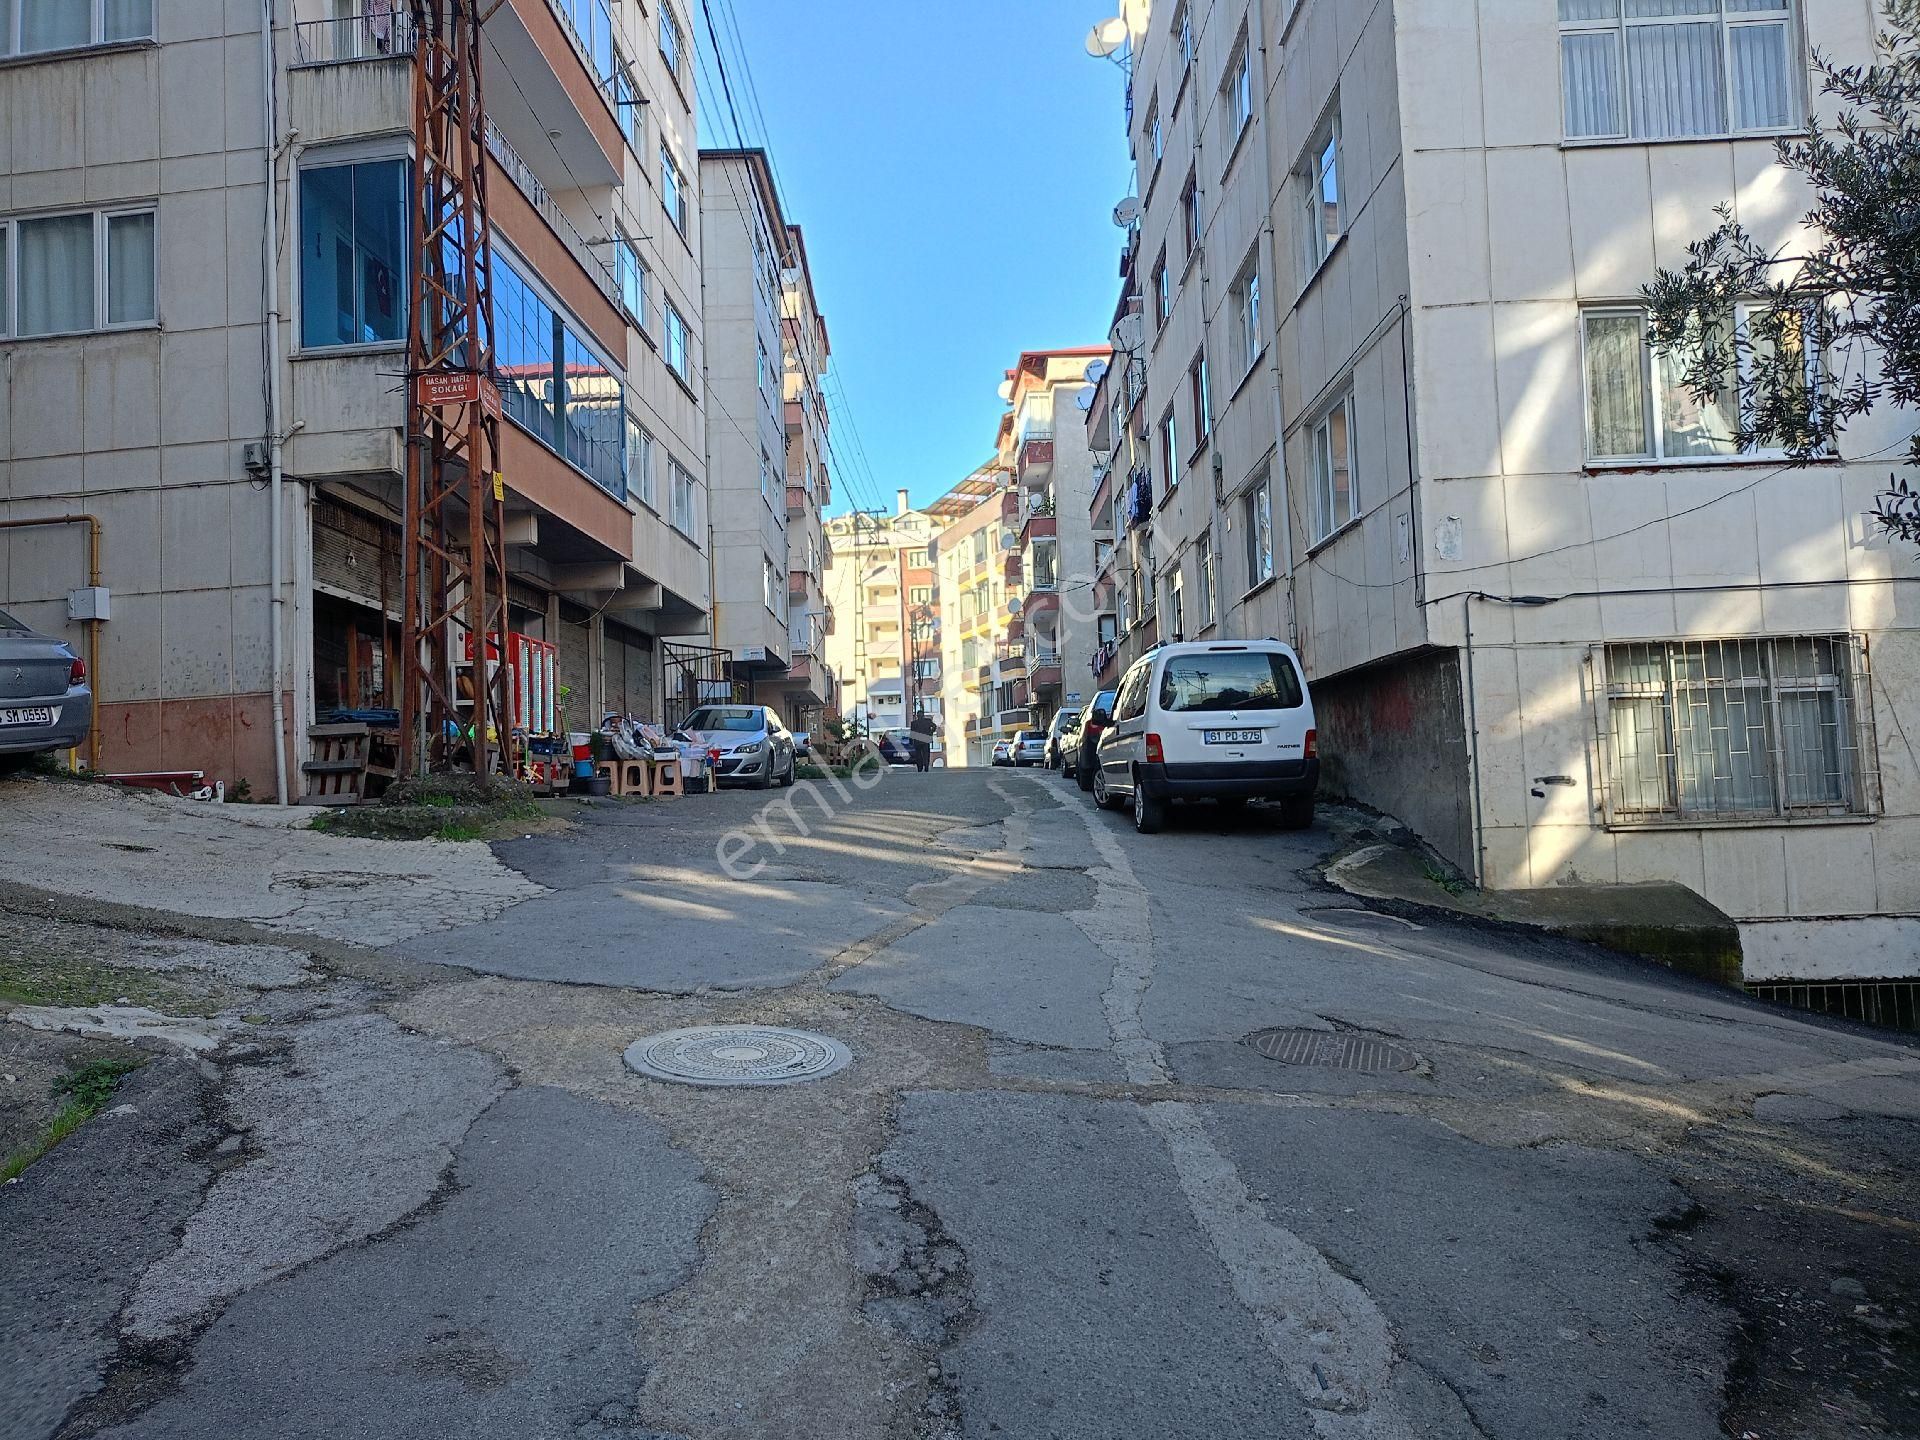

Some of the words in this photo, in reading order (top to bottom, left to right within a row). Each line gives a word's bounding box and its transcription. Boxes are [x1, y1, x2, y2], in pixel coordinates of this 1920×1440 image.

[426, 377, 448, 385] HASAN
[22, 708, 48, 721] 0555
[1210, 731, 1221, 741] 61
[1225, 731, 1238, 741] PD
[1242, 731, 1260, 740] 875
